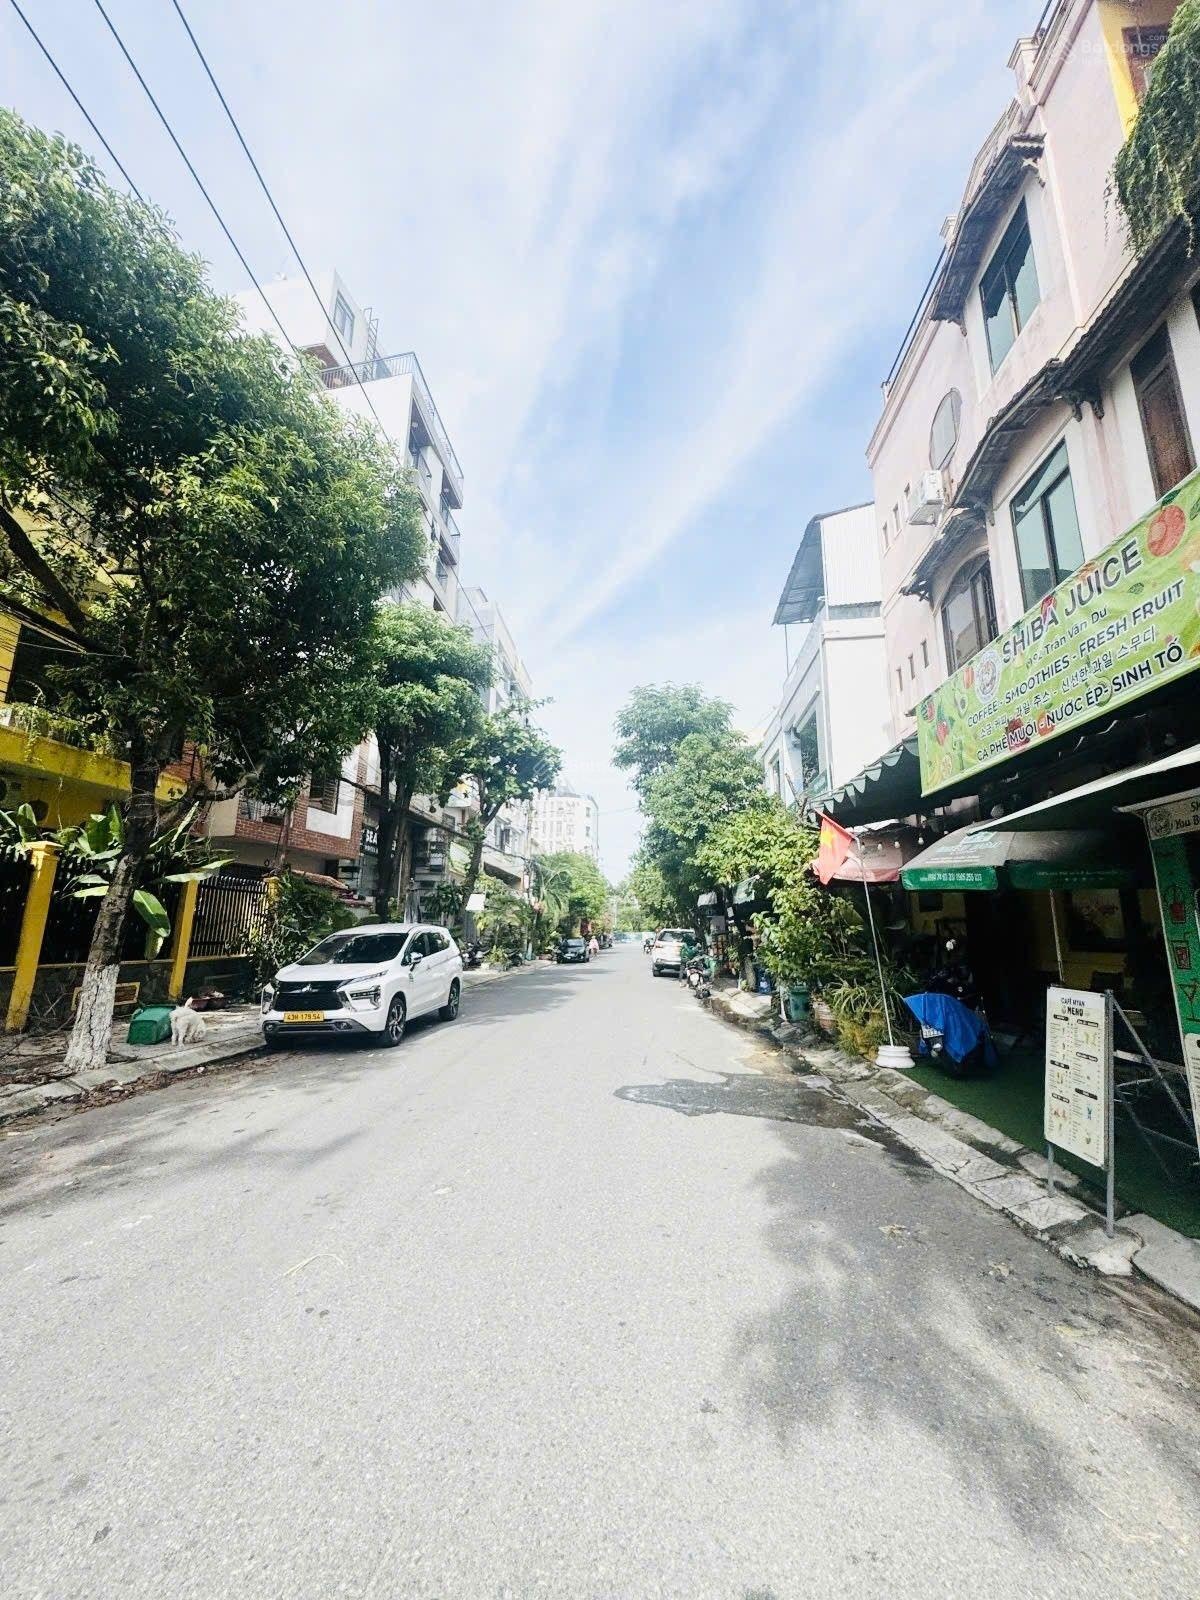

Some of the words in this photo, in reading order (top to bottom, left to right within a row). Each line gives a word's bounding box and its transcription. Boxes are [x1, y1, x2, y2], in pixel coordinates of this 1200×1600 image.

[1003, 604, 1059, 663] SHIBA
[1065, 540, 1141, 616] JUICE
[967, 701, 998, 727] COFFEE
[1006, 655, 1069, 703] SMOOTHIES
[1080, 620, 1126, 657] FRESH
[1133, 580, 1182, 625] FRUIT
[1034, 690, 1049, 707] 주스
[1092, 650, 1112, 675] 과일
[1118, 626, 1155, 659] 스무디
[1046, 697, 1082, 725] NƯỚC
[1112, 660, 1151, 692] SINH
[1155, 638, 1182, 669] TỐ
[1067, 1006, 1084, 1016] MENU
